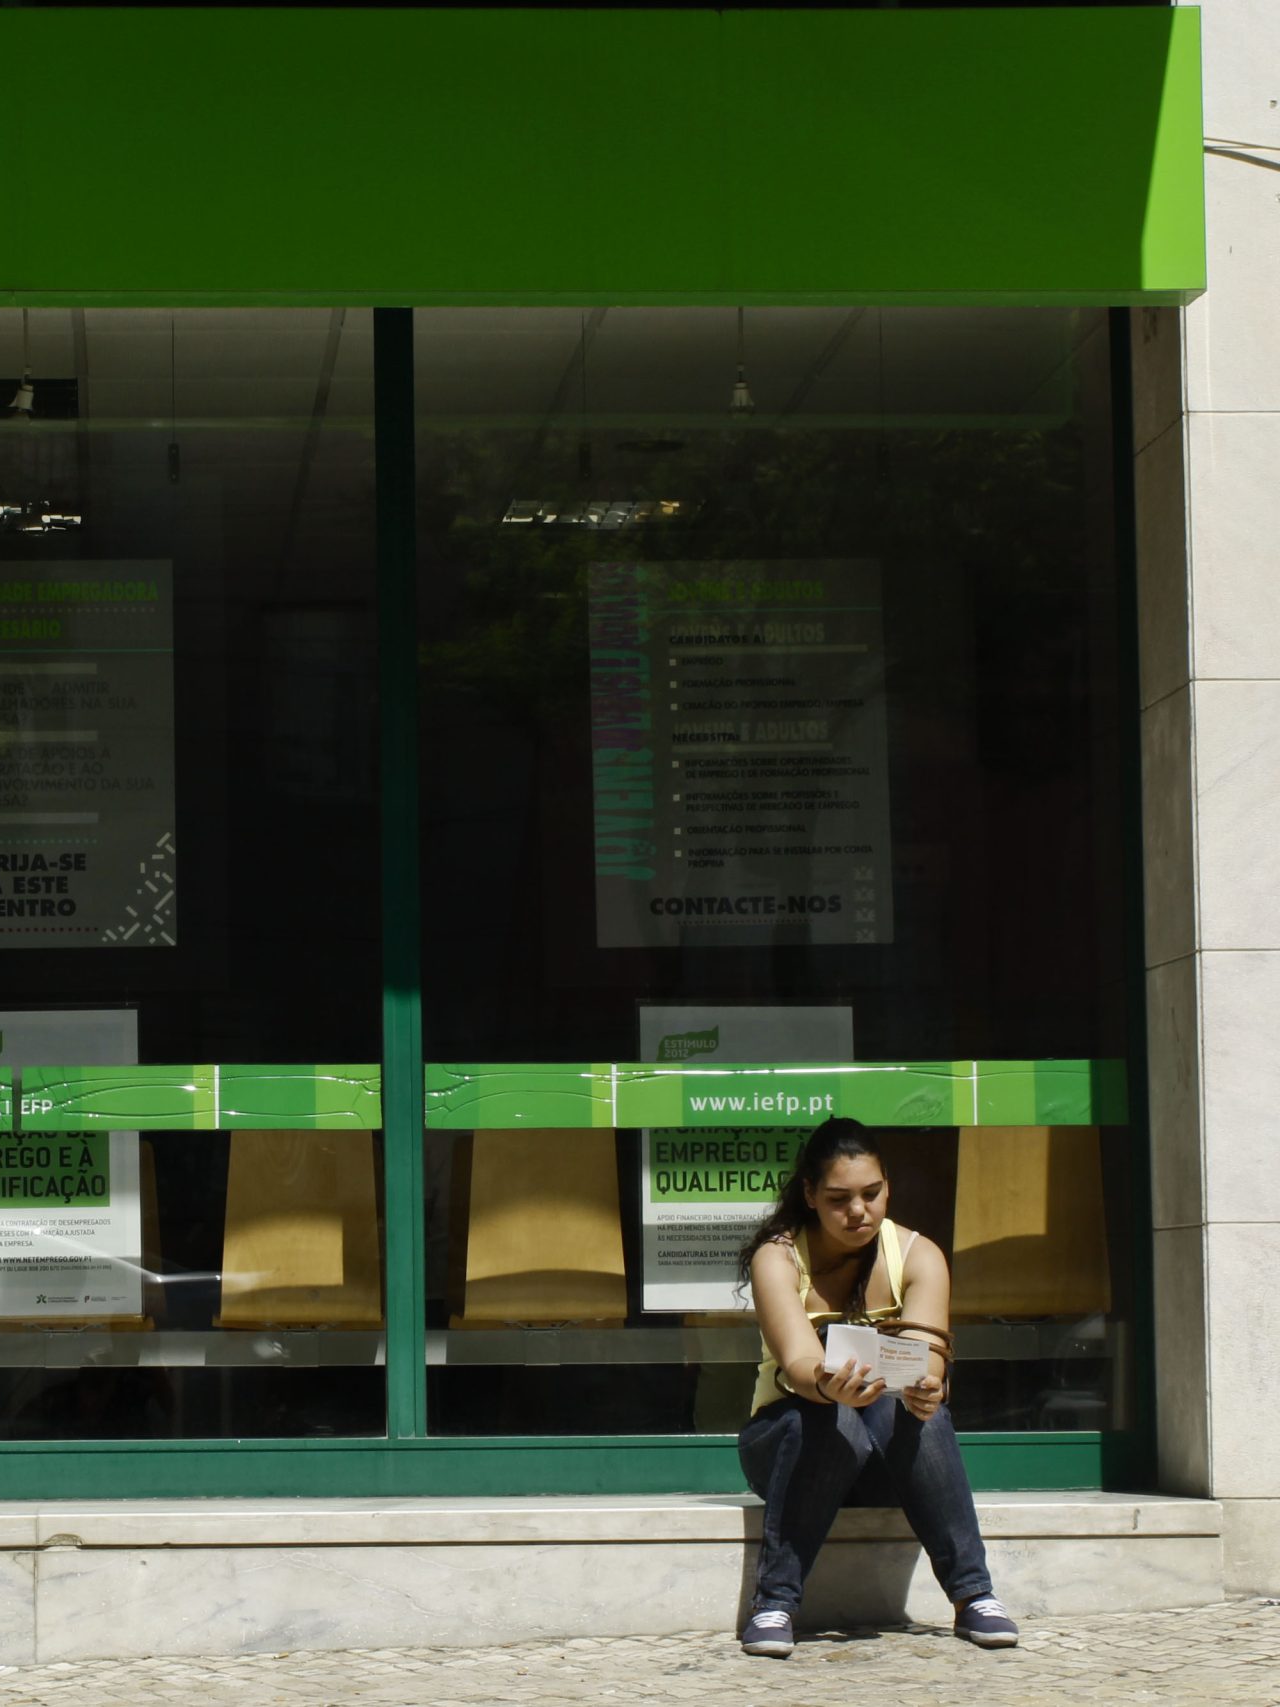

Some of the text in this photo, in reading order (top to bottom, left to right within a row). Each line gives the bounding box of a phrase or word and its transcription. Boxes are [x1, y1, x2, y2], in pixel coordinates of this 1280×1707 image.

[13, 876, 69, 895] ESTE
[649, 895, 843, 915] CONTACTE-NOS
[663, 1037, 717, 1050] ESTÍMULO
[663, 1049, 689, 1058] 2012
[5, 1099, 53, 1115] IEFP
[689, 1092, 834, 1115] www.iefp.pt
[59, 1146, 72, 1168] E
[77, 1138, 93, 1168] À
[656, 1141, 789, 1164] EMPREGO E
[657, 1224, 666, 1232] HÁ
[657, 1250, 708, 1258] CANDIDATURAS
[709, 1250, 720, 1258] EM
